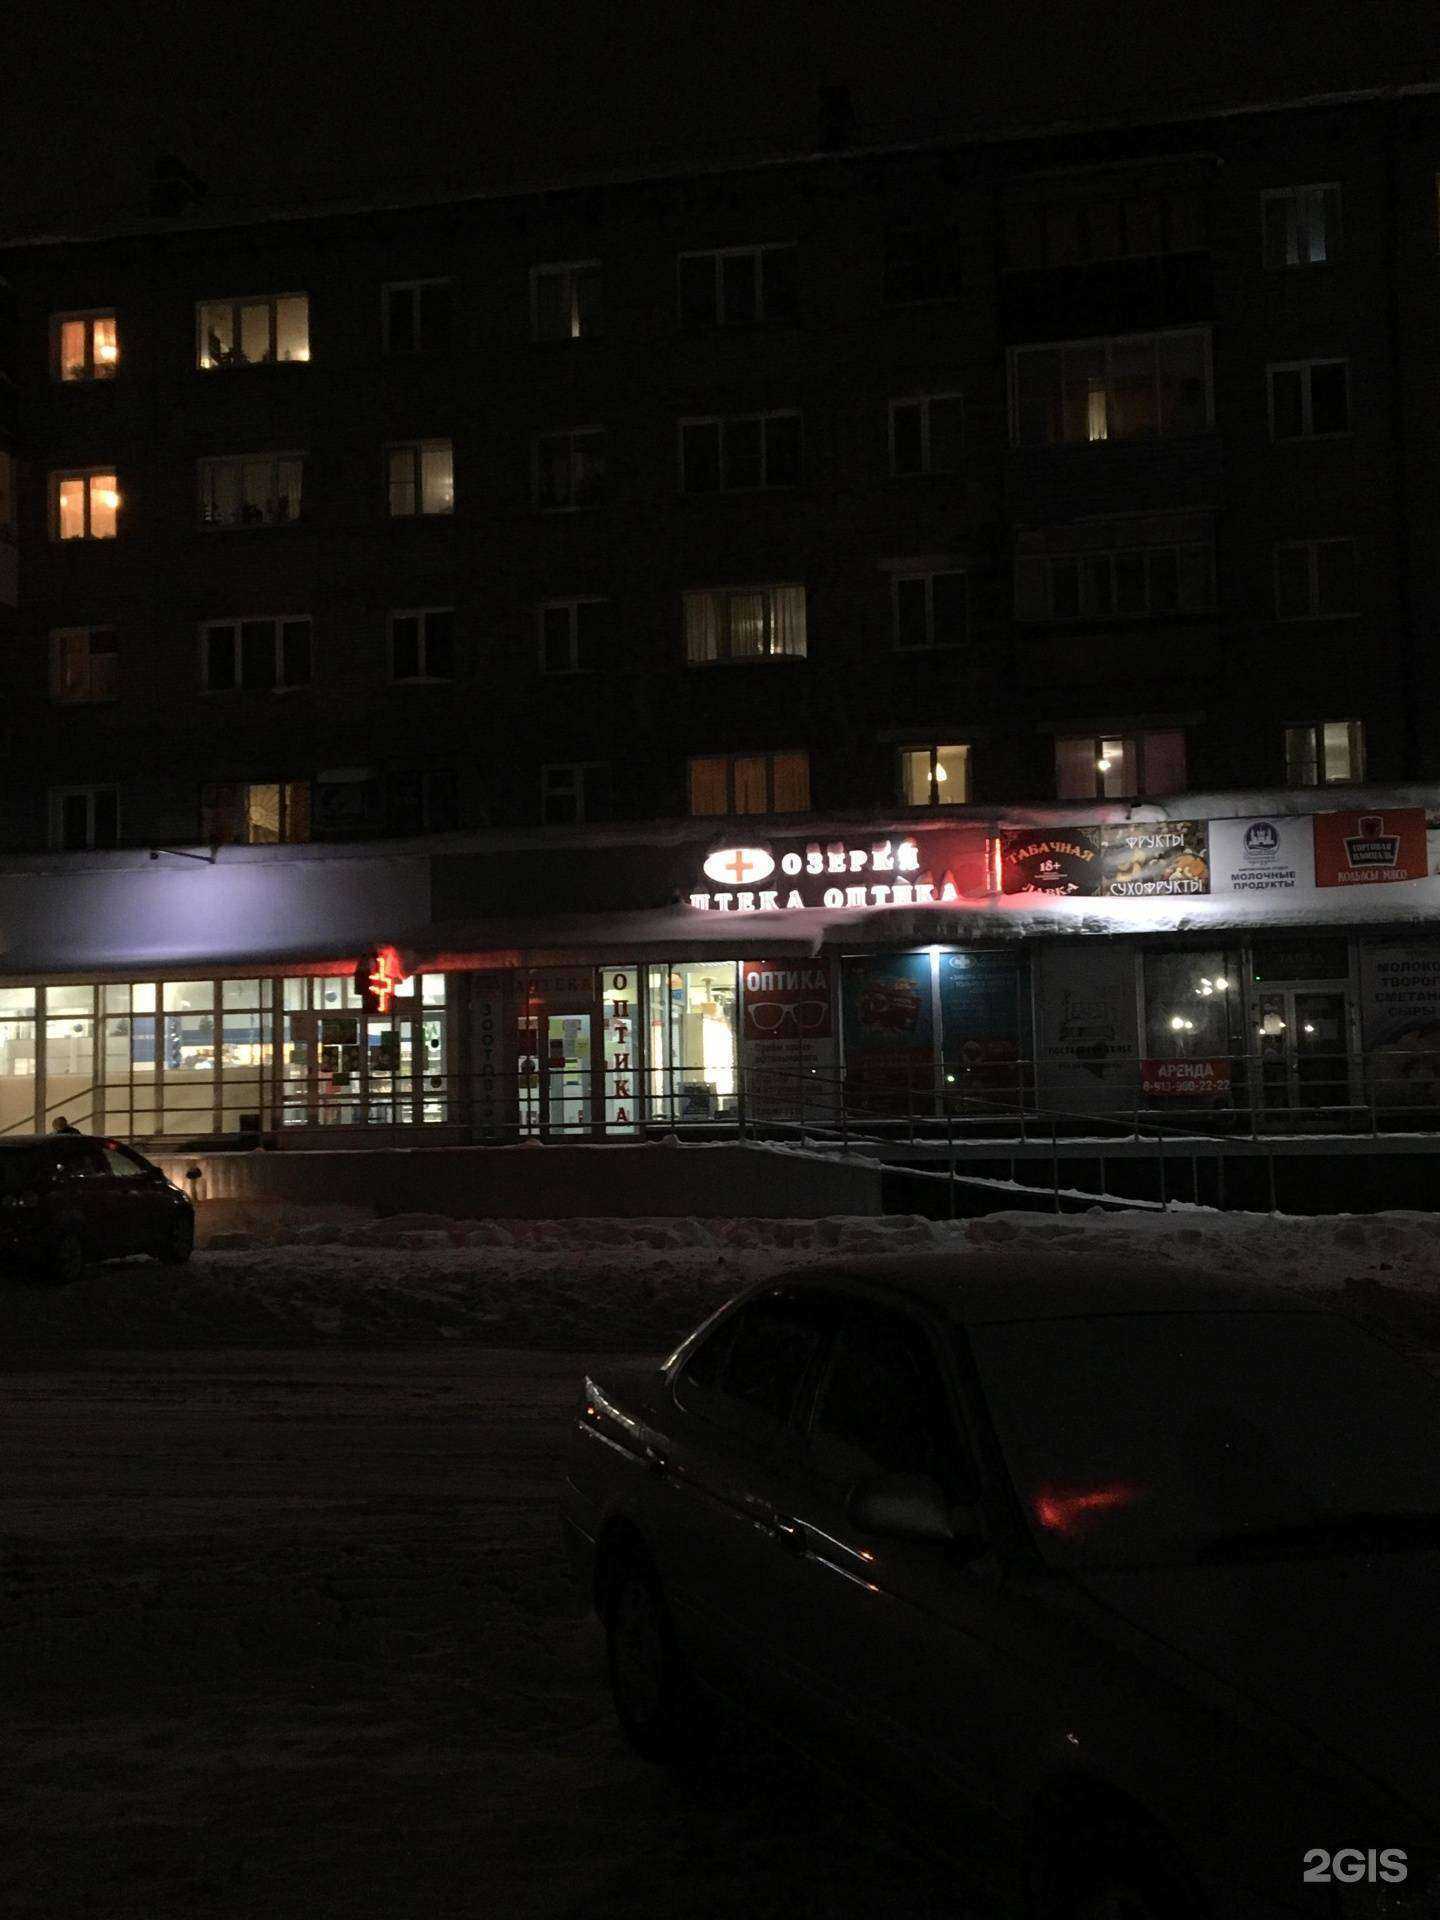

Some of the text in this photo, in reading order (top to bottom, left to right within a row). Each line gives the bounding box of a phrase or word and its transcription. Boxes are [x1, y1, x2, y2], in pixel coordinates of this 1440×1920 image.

[1126, 833, 1185, 848] ФРУКТЫ
[781, 840, 920, 875] ОЗЕРКИ
[1008, 842, 1095, 864] ТАБАЧНАЯ
[1039, 859, 1061, 872] 18+
[1231, 871, 1296, 881] МОЛОЧНЫЕ
[1110, 880, 1203, 896] СУХОФРУКТЫ
[1233, 880, 1295, 890] ПРОДУКТЫ
[746, 970, 827, 992] ОПТИКА
[1376, 991, 1440, 1002] СМЕТАН
[613, 973, 628, 1125] ОПТИКА
[1158, 1063, 1214, 1078] АРЕНДА
